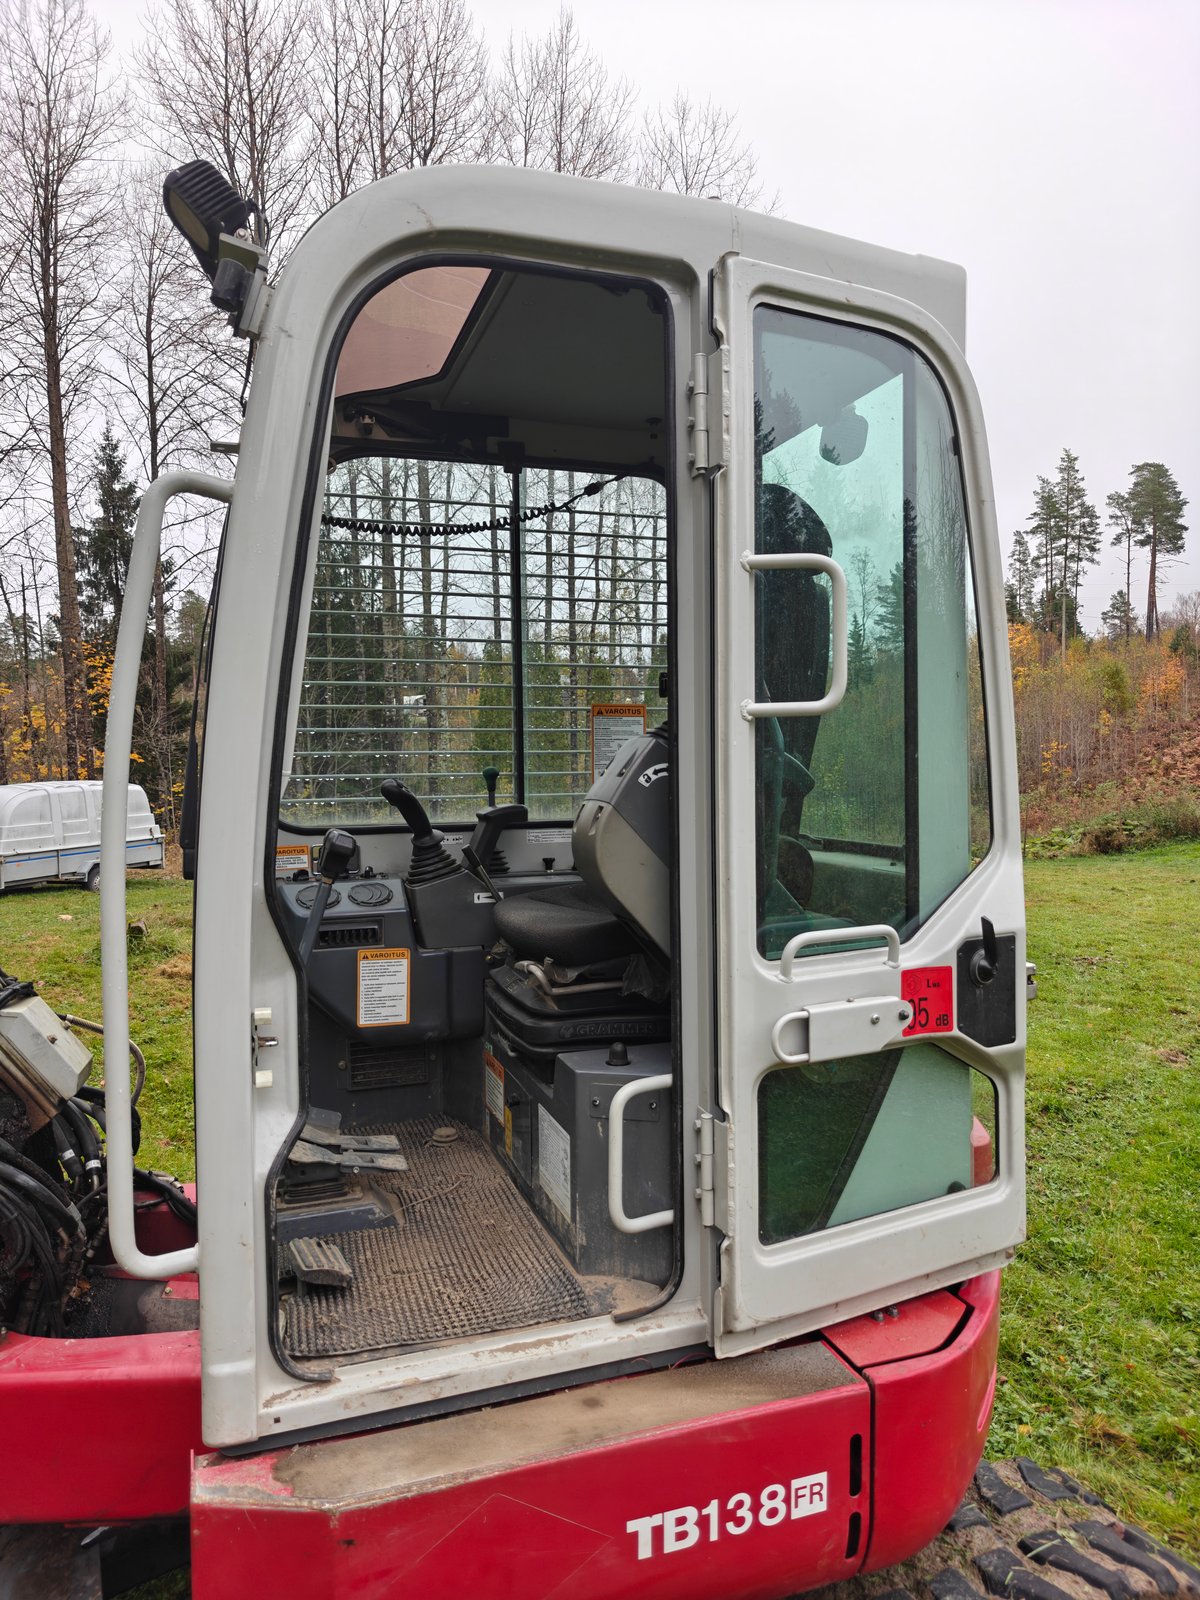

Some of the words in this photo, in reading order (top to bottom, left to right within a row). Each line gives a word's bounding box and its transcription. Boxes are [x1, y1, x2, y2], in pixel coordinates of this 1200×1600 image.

[370, 951, 406, 959] VAROITUS
[935, 1013, 949, 1027] dB
[576, 1022, 656, 1036] GRAMMER
[626, 1483, 787, 1561] TB138
[793, 1481, 825, 1510] FR
